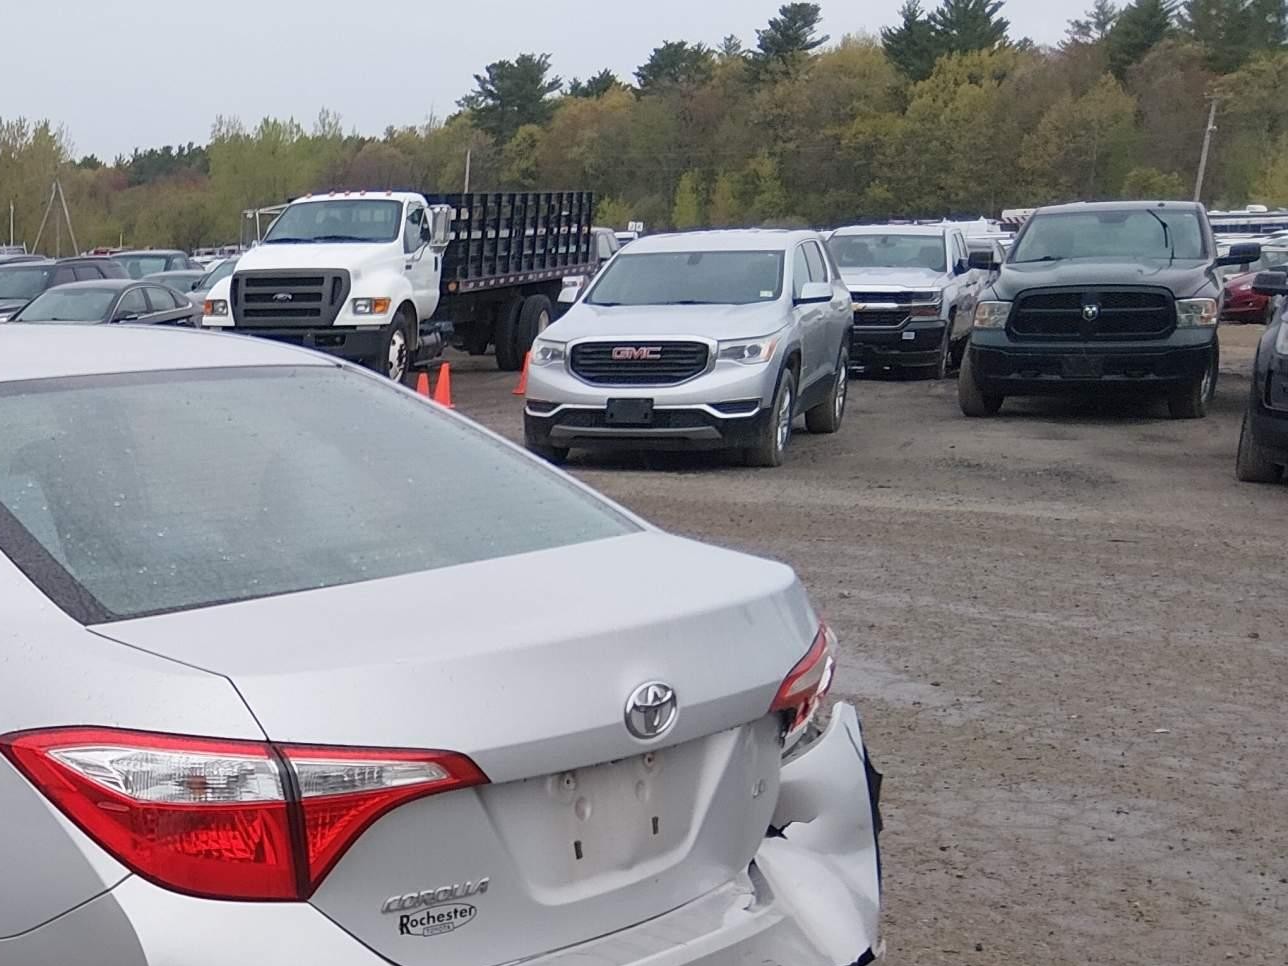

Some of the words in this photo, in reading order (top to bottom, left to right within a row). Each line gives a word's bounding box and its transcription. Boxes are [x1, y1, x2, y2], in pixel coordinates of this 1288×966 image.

[612, 346, 662, 359] GMC
[381, 877, 490, 914] COROLLA
[399, 906, 475, 935] Rochester
